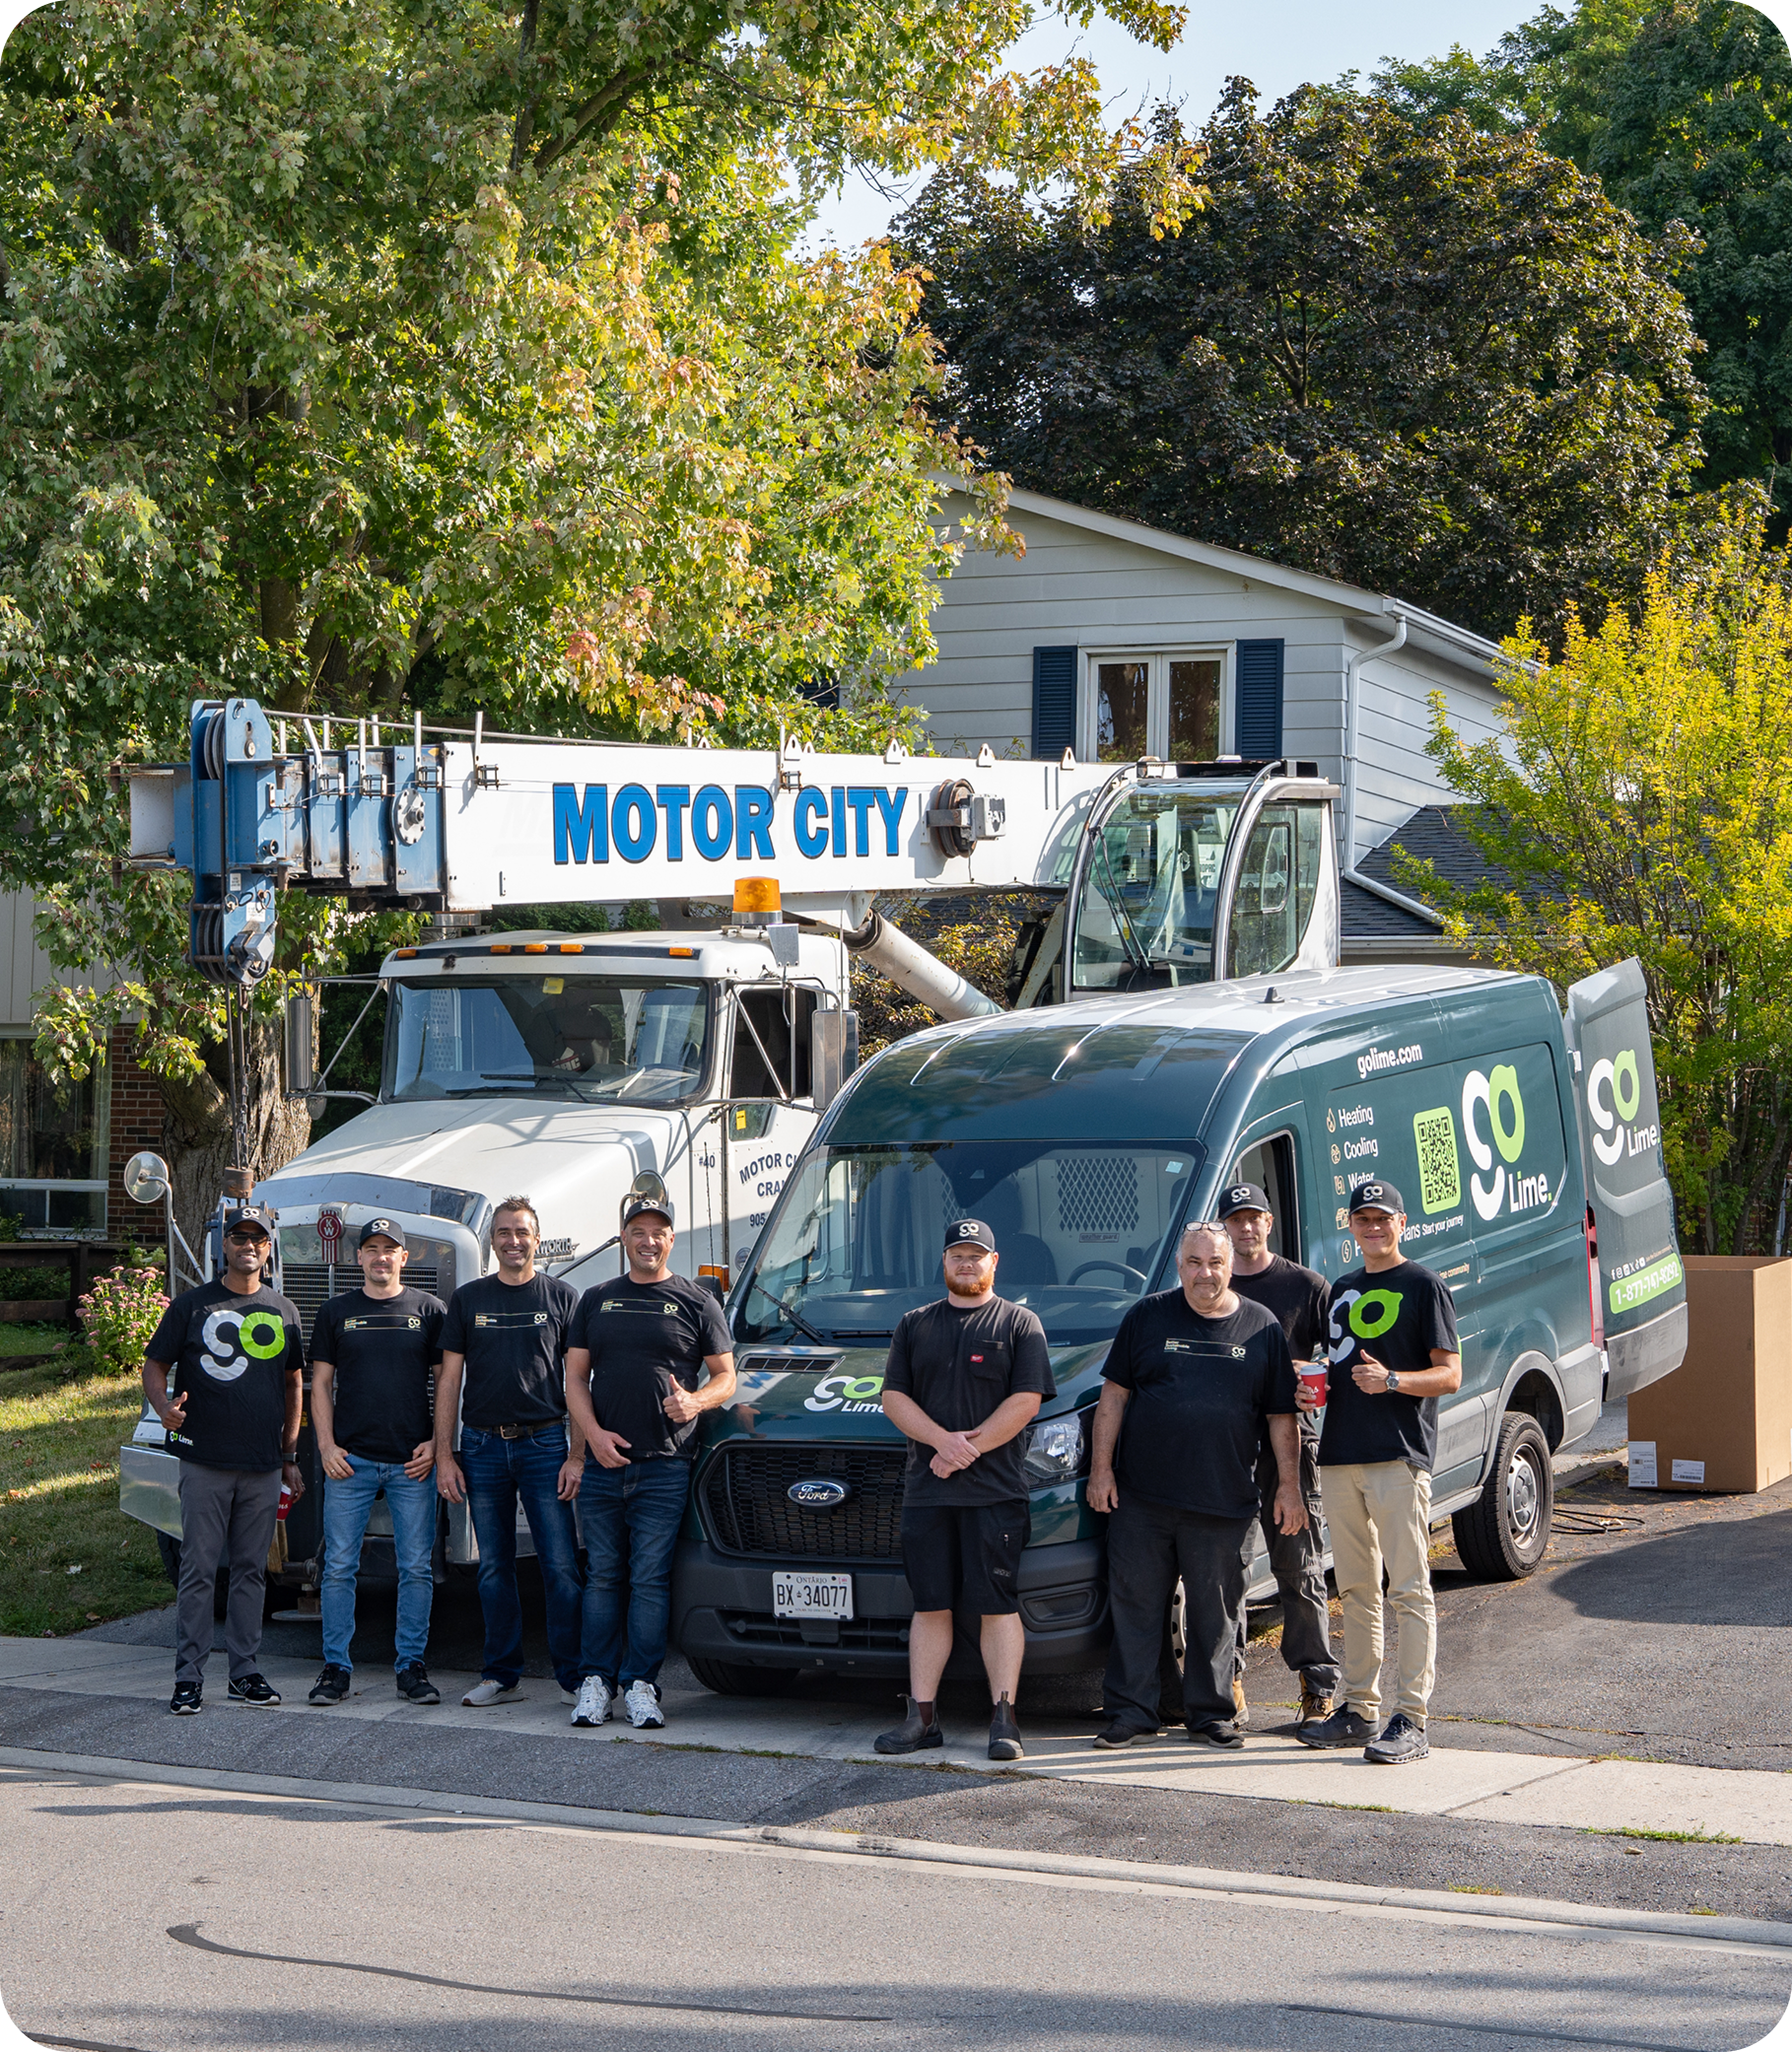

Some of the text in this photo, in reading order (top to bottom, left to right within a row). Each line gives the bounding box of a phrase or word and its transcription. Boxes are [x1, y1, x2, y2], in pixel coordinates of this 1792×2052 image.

[552, 783, 776, 865] MOTOR
[793, 785, 909, 859] CITY
[1357, 1044, 1423, 1079] golime.com
[1338, 1105, 1374, 1128] Heating
[1587, 1049, 1640, 1166] go
[1344, 1137, 1379, 1160] Cooling
[1462, 1064, 1525, 1221] go
[739, 1153, 797, 1184] MOTOR CI
[1508, 1171, 1552, 1213] Lime.
[535, 1237, 572, 1254] WORTH
[1615, 1261, 1680, 1305] 1-877-747-8292
[200, 1310, 285, 1381] go
[798, 1484, 830, 1500] Ford
[777, 1585, 848, 1607] BX 34077
